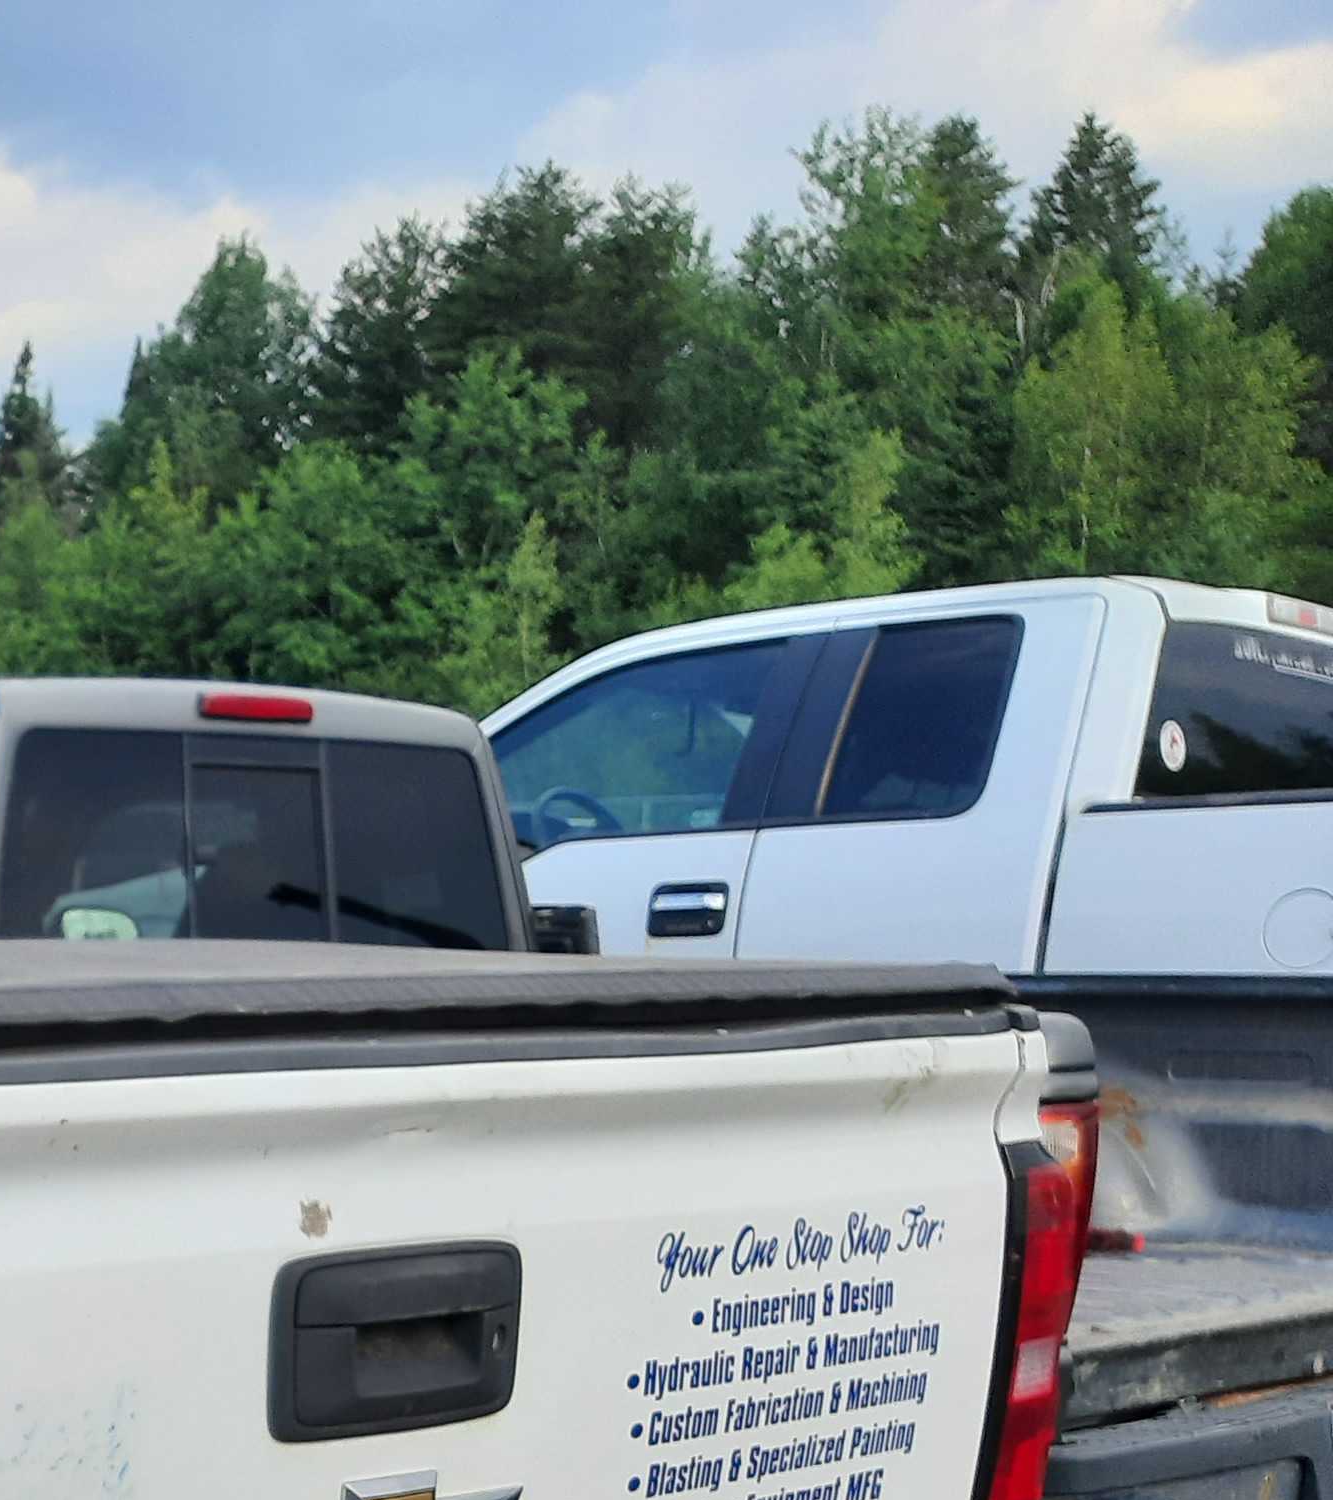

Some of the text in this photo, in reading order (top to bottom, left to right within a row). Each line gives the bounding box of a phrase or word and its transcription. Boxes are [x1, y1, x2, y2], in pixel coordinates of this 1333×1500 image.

[657, 1204, 946, 1293] Your One Stop Shop For:
[712, 1277, 894, 1338] Engineering & Design
[644, 1320, 939, 1400] Hydraulic Repair & Manufacturing
[648, 1369, 928, 1446] Custom Fabrication & Machining
[646, 1420, 916, 1499] Blasting & Specialized Painting
